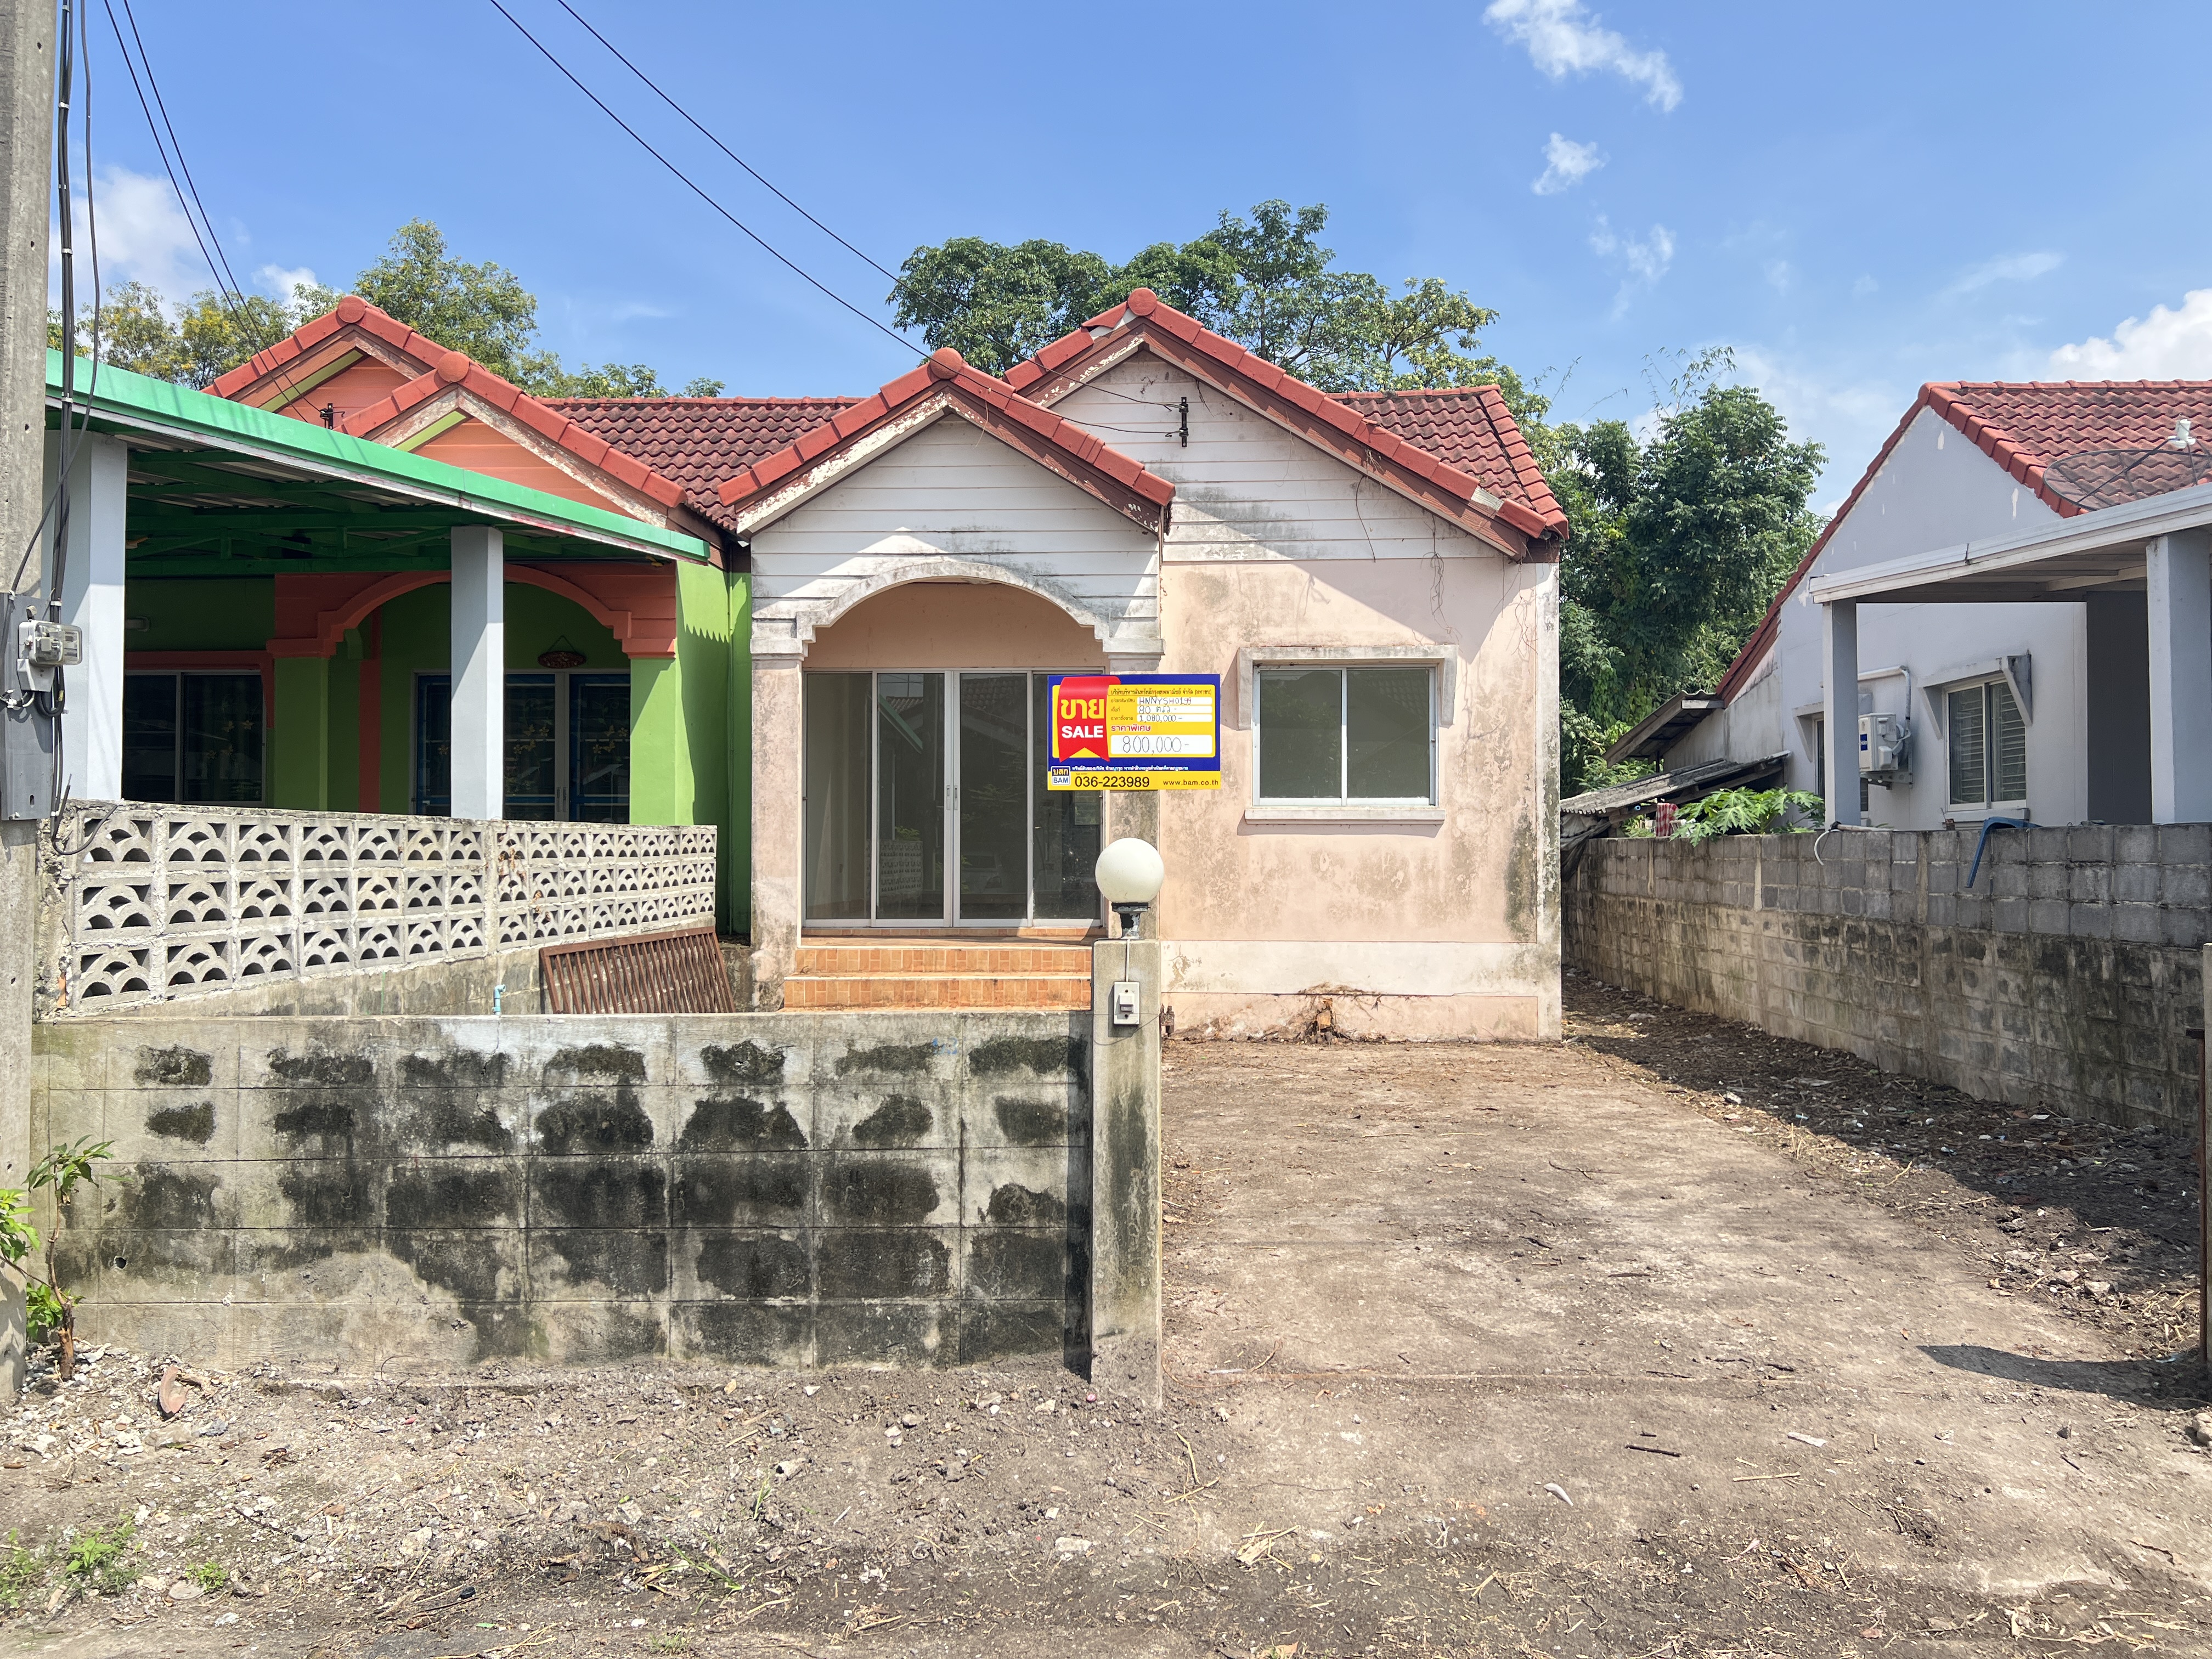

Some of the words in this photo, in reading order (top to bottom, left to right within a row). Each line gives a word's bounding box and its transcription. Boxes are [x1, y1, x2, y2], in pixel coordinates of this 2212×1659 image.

[1061, 698, 1104, 720] ขาย
[1139, 706, 1151, 714] 80
[1062, 725, 1103, 738] SALE
[1111, 724, 1151, 732] ราคาพิเศษ
[1053, 768, 1069, 776] บสก
[1075, 776, 1150, 788] 036-223989
